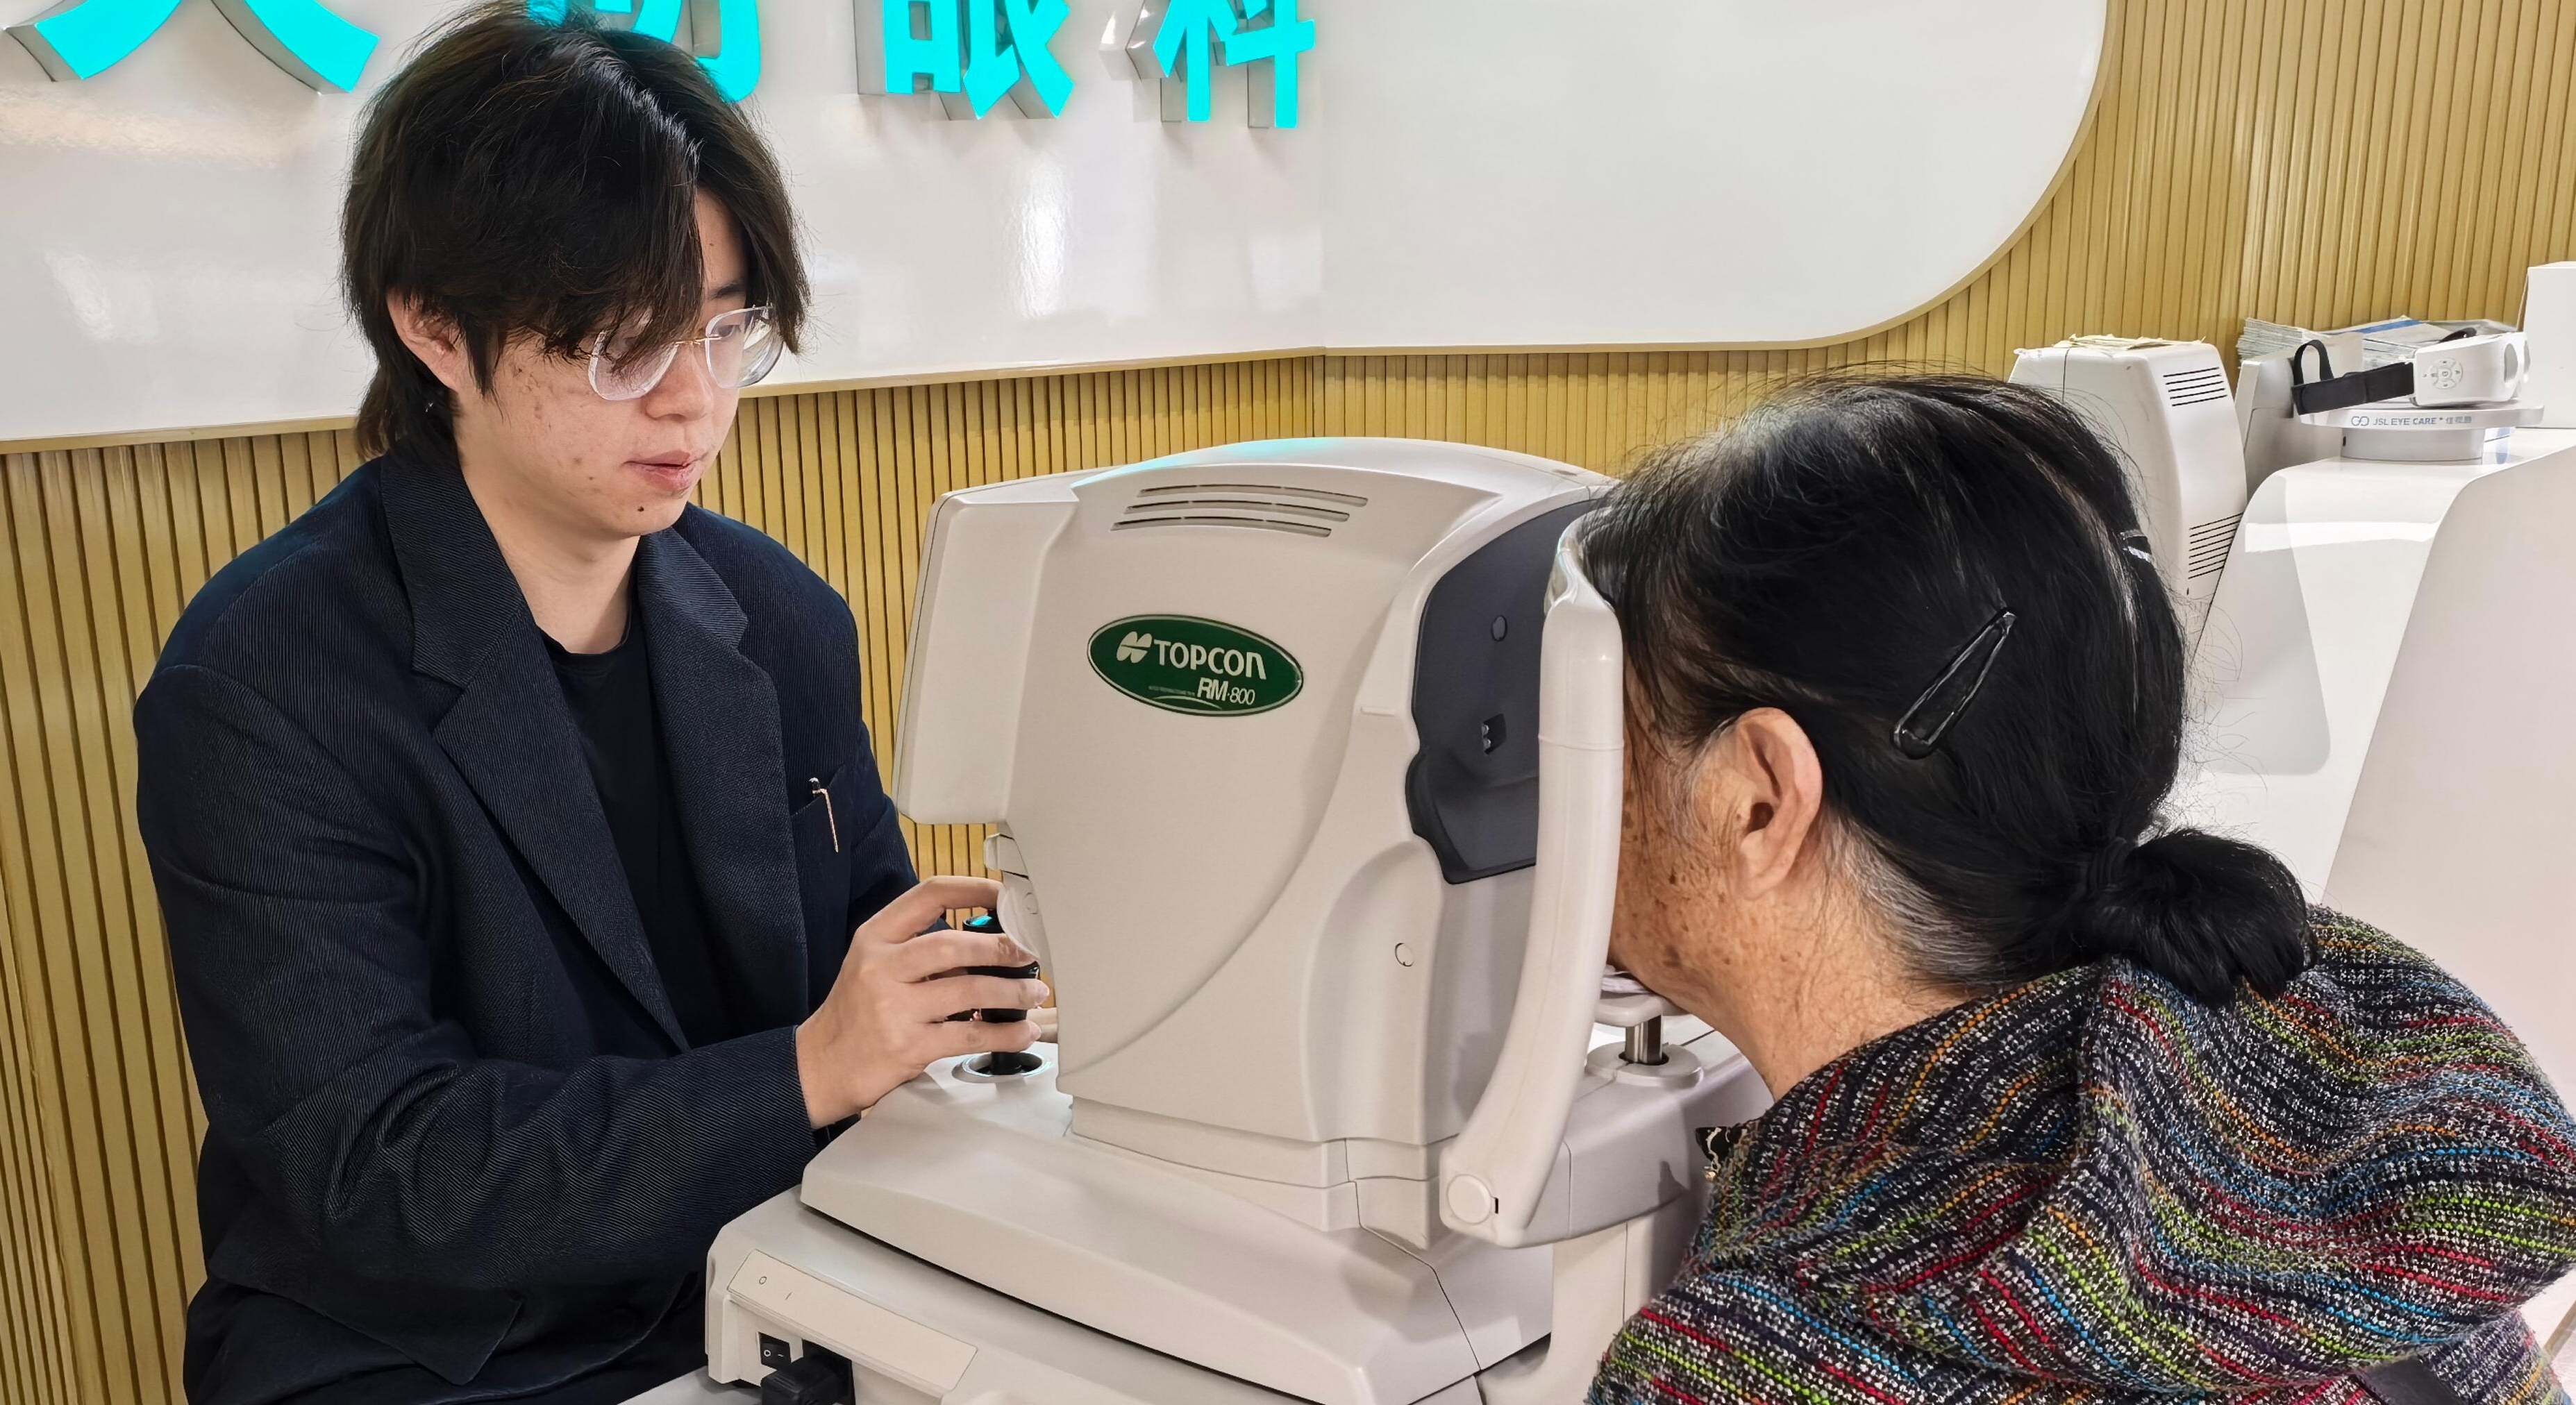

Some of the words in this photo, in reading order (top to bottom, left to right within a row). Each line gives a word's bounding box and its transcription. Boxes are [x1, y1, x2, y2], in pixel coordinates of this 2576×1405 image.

[2373, 417, 2389, 426] JSL
[2391, 417, 2410, 426] EYE
[2413, 417, 2437, 425] CARE
[1153, 639, 1267, 680] TOPCON
